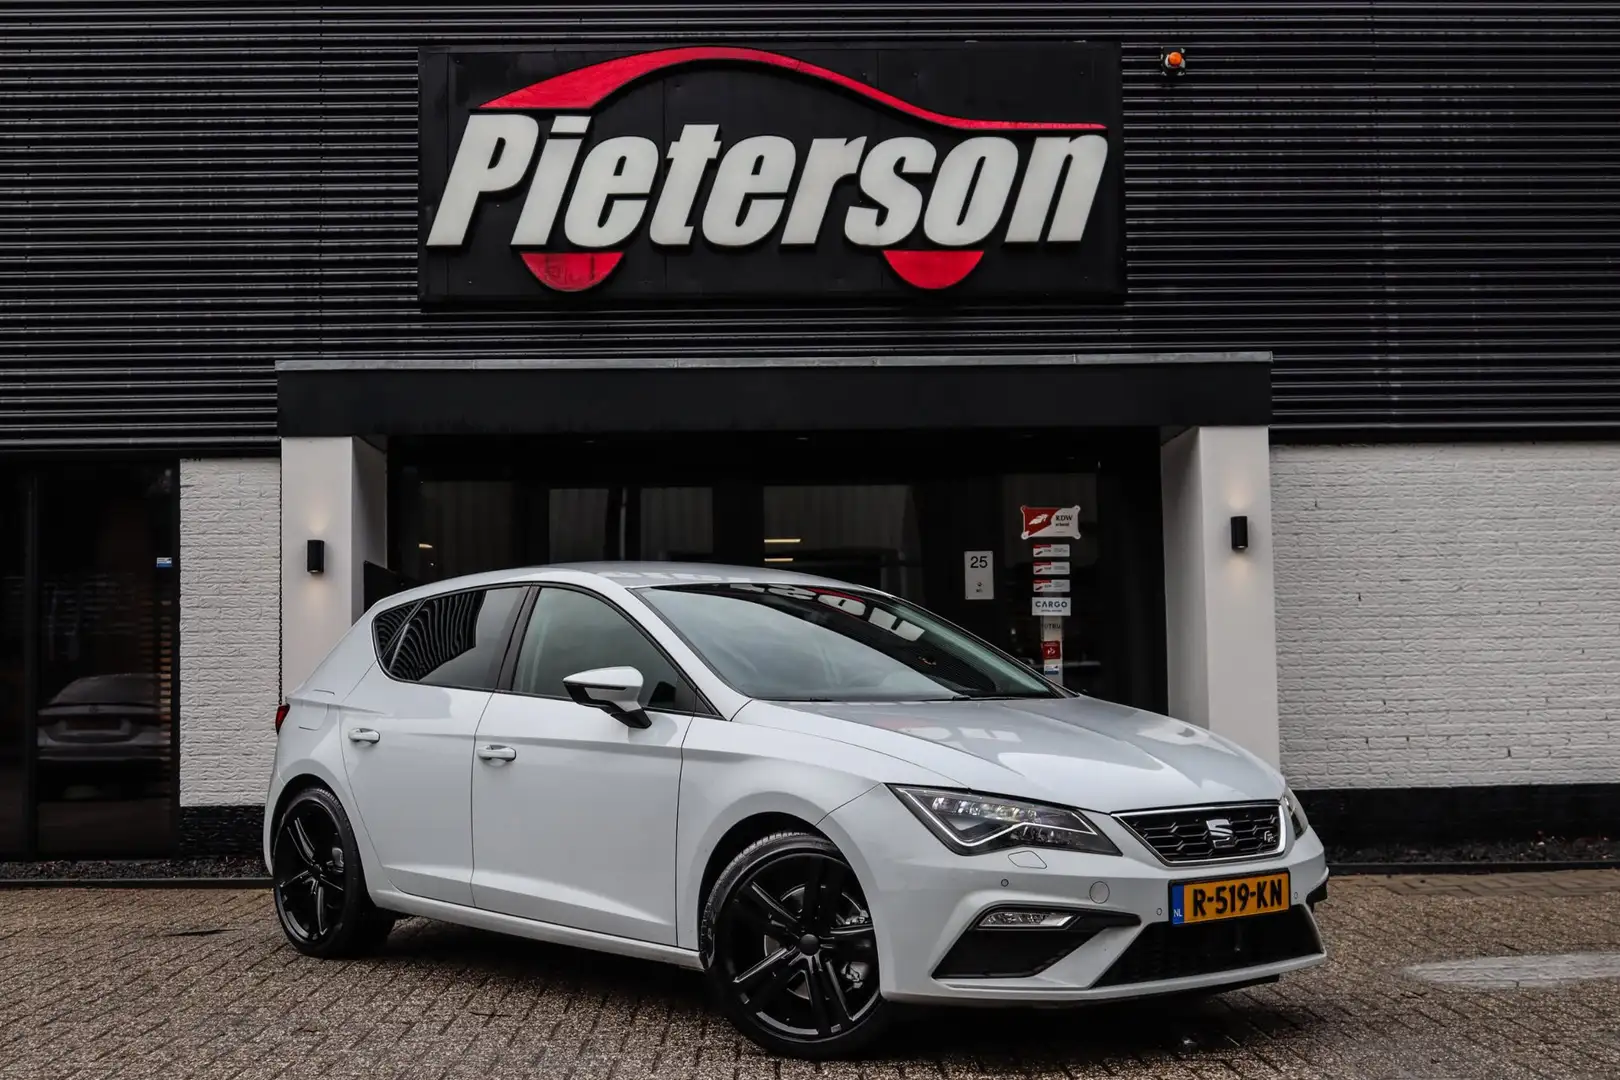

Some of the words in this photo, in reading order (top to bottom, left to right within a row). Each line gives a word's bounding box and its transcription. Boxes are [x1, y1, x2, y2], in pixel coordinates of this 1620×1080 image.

[426, 113, 1109, 248] Pieterson
[970, 555, 988, 568] 25
[1035, 600, 1068, 608] CARGO
[1193, 878, 1283, 917] R-519-KN
[1173, 908, 1183, 917] NL
